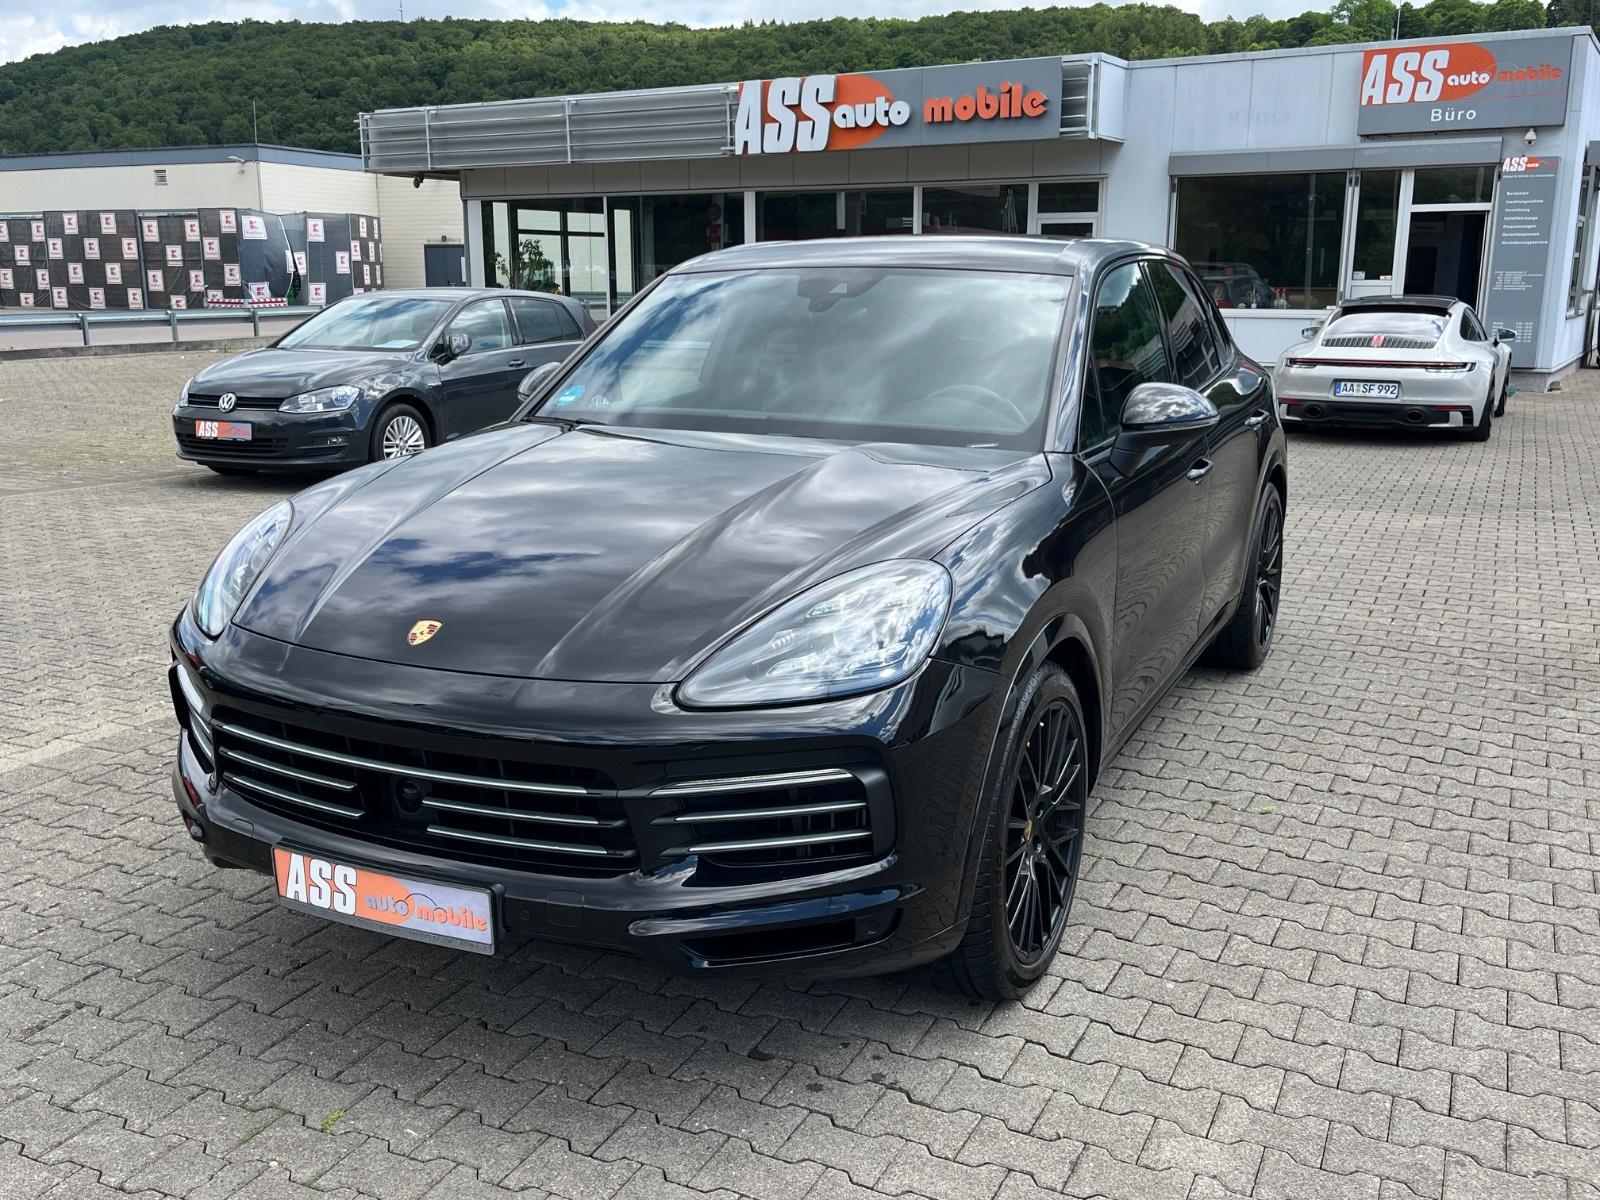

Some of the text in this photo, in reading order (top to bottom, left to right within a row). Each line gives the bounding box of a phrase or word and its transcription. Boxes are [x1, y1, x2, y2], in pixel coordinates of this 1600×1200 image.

[1361, 50, 1563, 106] ASS auto mobile
[734, 74, 1048, 155] ASS auto mobile
[1430, 108, 1477, 122] Büro
[1502, 157, 1528, 172] ASS
[1341, 383, 1397, 395] AA SF 992
[198, 420, 219, 437] ASS
[285, 852, 489, 932] ASS auto mobile
